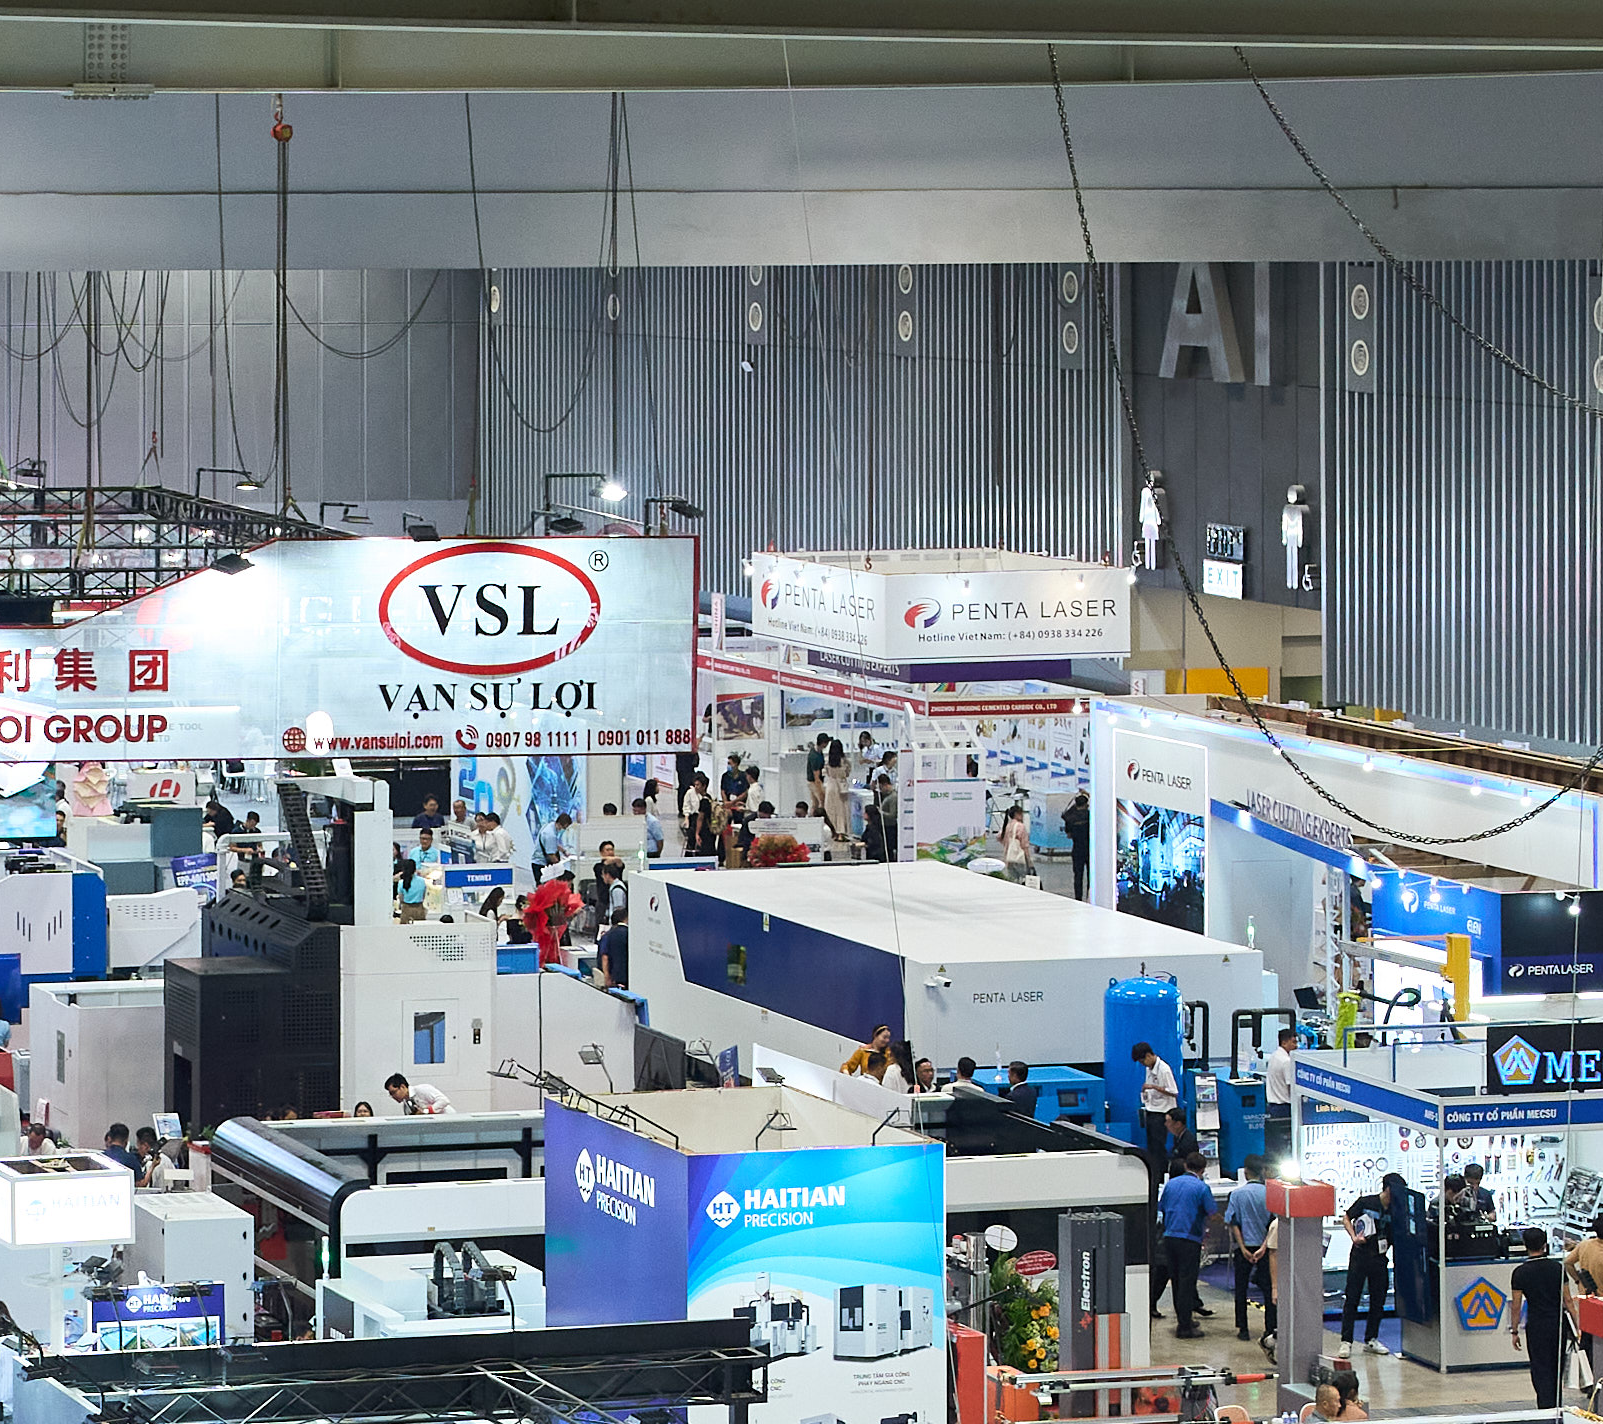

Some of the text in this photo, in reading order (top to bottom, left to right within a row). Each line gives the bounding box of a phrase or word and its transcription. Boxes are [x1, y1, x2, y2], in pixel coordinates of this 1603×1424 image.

[1208, 566, 1239, 588] EXIT
[418, 583, 560, 637] VSL
[784, 581, 875, 622] PENTA LASER
[952, 598, 1117, 622] PENTA LASER
[918, 628, 1103, 644] Hotline Viet 0938 334 226
[378, 677, 598, 720] VẠN SỰ LỢI
[43, 713, 169, 744] GROUP
[486, 730, 578, 748] 0907 98 1111
[597, 727, 691, 747] 0901 011 888
[1142, 770, 1191, 790] PENTA LASER
[972, 991, 1044, 1004] PENTA LASER
[1447, 1107, 1557, 1124] CÔNG TY MECSU
[595, 1153, 656, 1209] HAITIAN
[595, 1190, 637, 1227] PRECISION
[743, 1185, 847, 1211] HAITIAN
[744, 1211, 815, 1229] PRECISION
[1079, 1251, 1092, 1313] Electron
